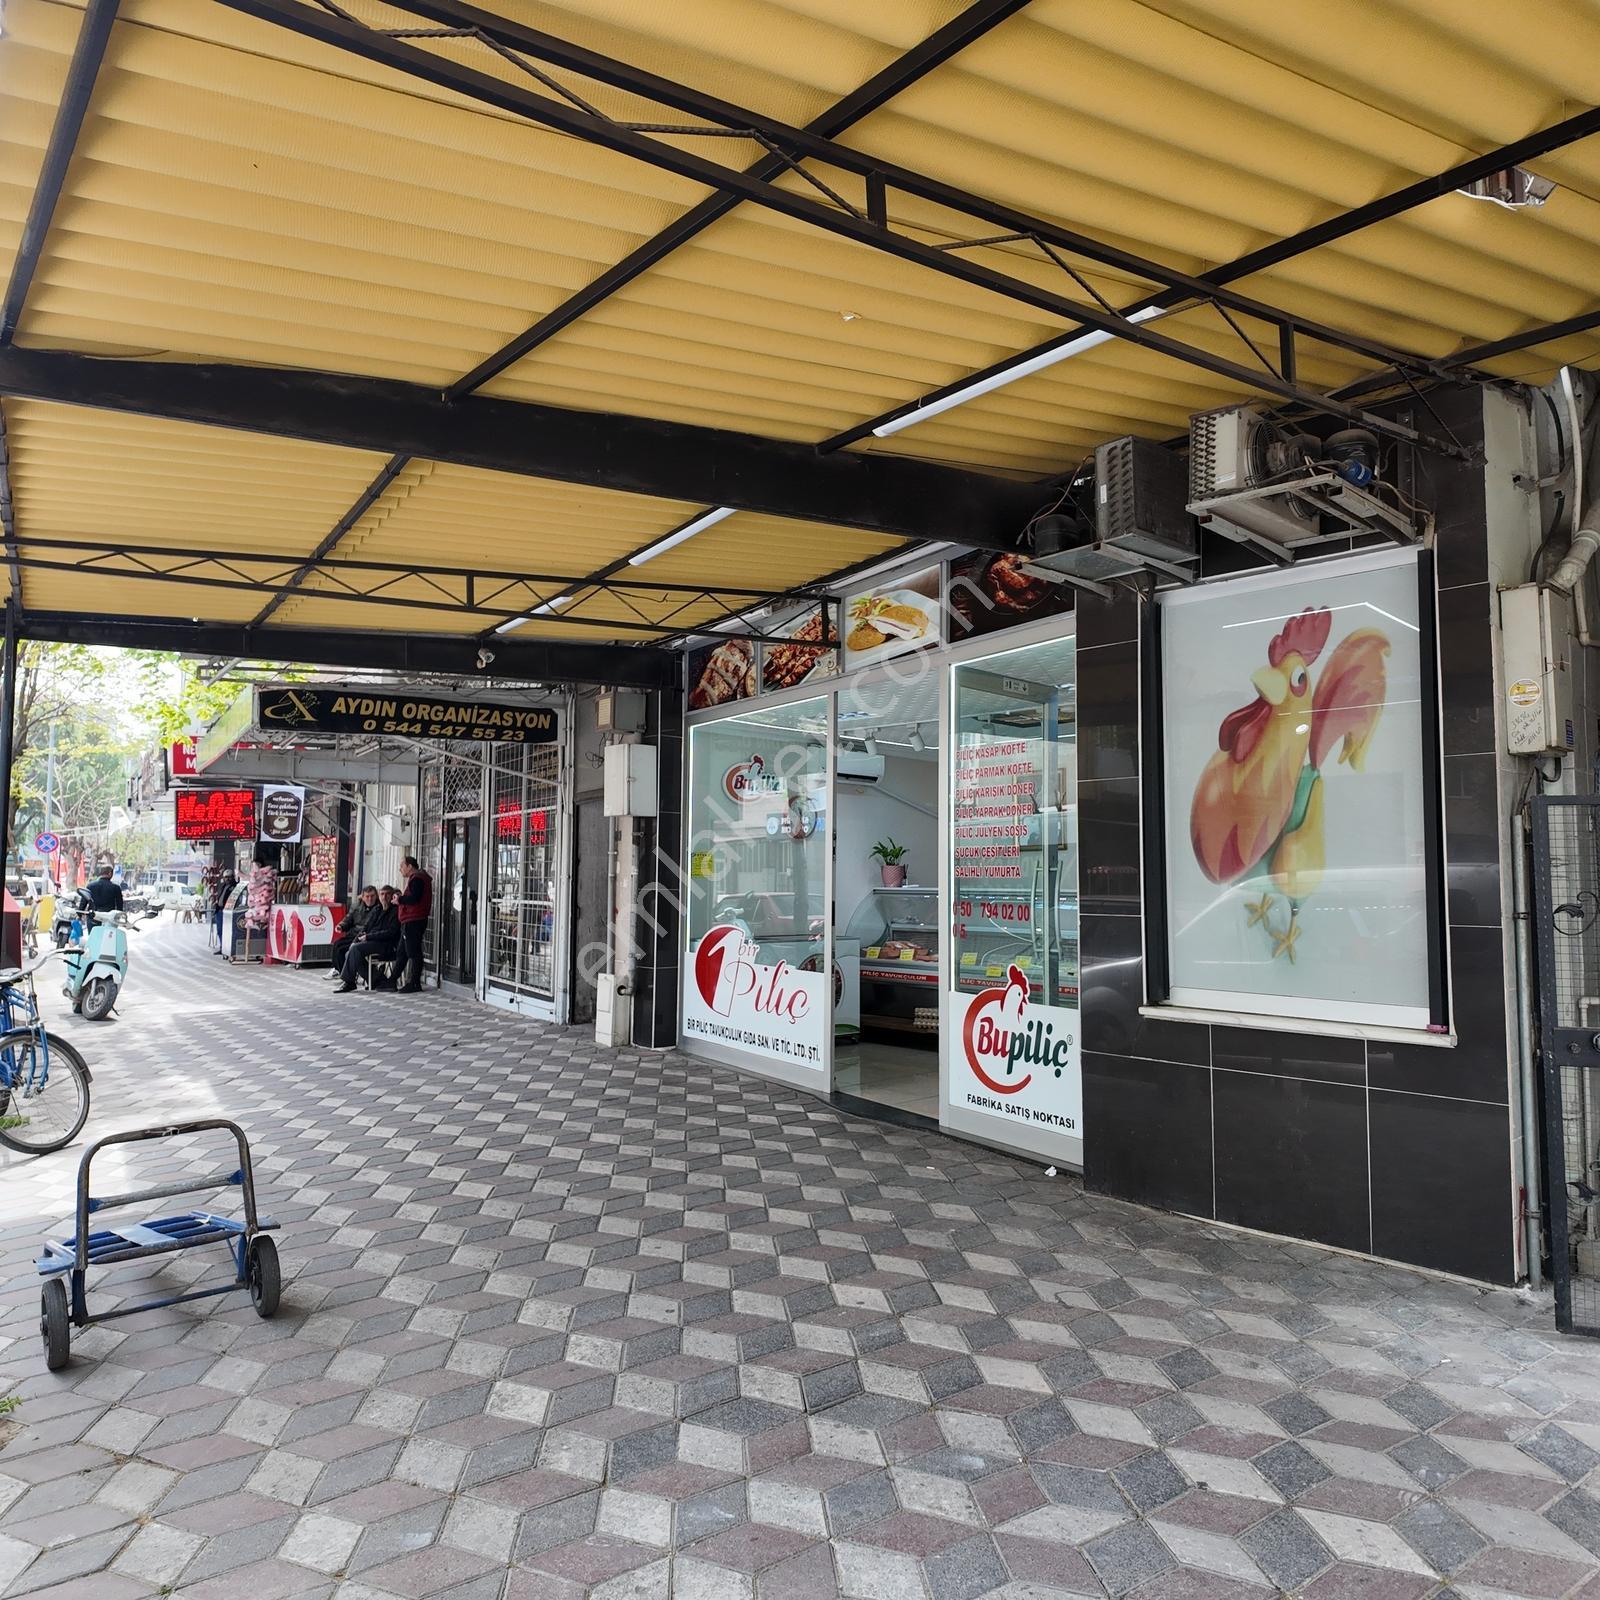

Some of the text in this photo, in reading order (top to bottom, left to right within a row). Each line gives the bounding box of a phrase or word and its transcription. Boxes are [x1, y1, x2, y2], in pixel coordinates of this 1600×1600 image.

[331, 696, 551, 729] AYDIN ORGANİZASYON
[363, 721, 526, 742] 0 544 547 55 23
[976, 746, 999, 759] KASAP
[976, 765, 1005, 779] PARMAK
[975, 804, 1003, 818] YAPRAK
[955, 846, 980, 858] SUCUK
[984, 866, 1021, 878] YUMURTA
[980, 902, 999, 919] 794
[1001, 902, 1014, 920] 02
[1017, 904, 1031, 922] 00
[724, 959, 810, 1025] Piliç
[687, 1015, 696, 1030] BİR
[743, 1031, 756, 1045] GIDA
[757, 1034, 771, 1049] SAN.
[772, 1037, 780, 1051] VE
[781, 1037, 792, 1054] TİC.
[793, 1042, 807, 1058] LTD.
[808, 1044, 821, 1063] ŞTİ.
[977, 1016, 1069, 1079] Bupiliç
[967, 1093, 1075, 1130] FABRİKA SATIŞ NOKTASI
